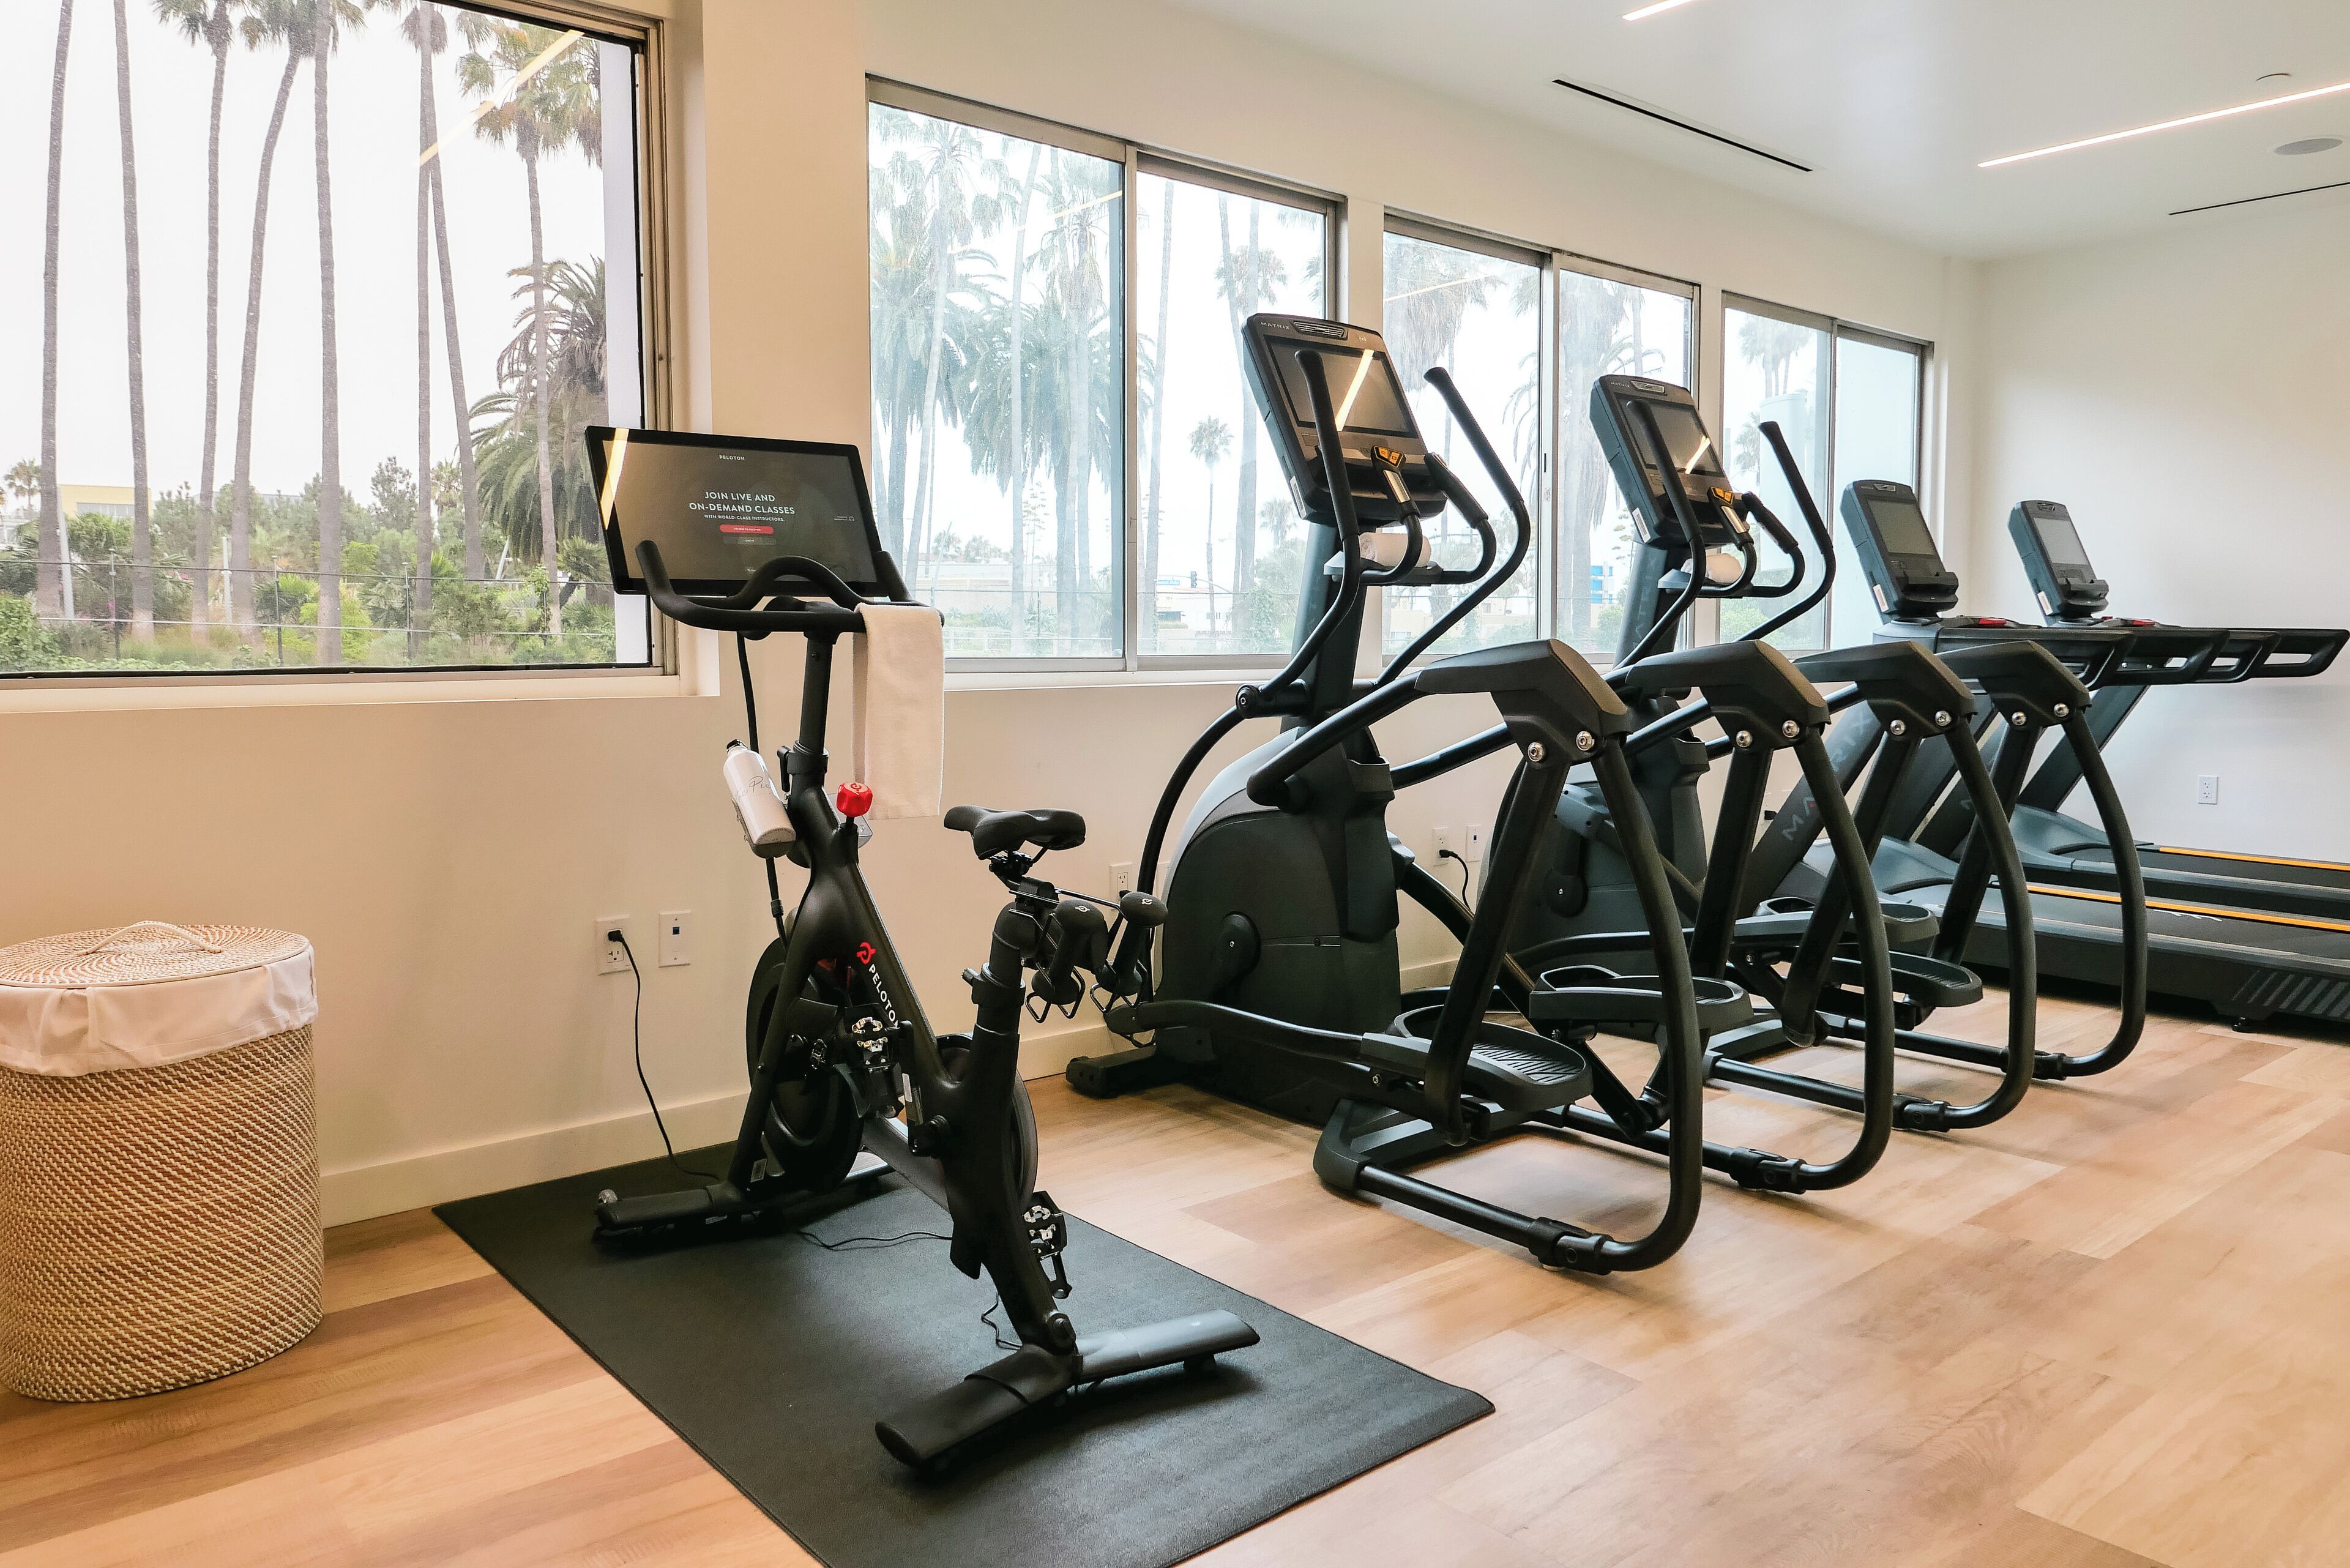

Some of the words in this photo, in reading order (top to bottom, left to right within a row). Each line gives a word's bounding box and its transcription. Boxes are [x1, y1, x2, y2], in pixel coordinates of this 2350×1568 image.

[1261, 321, 1289, 330] MATRIX
[689, 502, 752, 512] ON-DEMAND
[755, 506, 795, 514] CLASSES
[1782, 710, 1874, 840] MARIX
